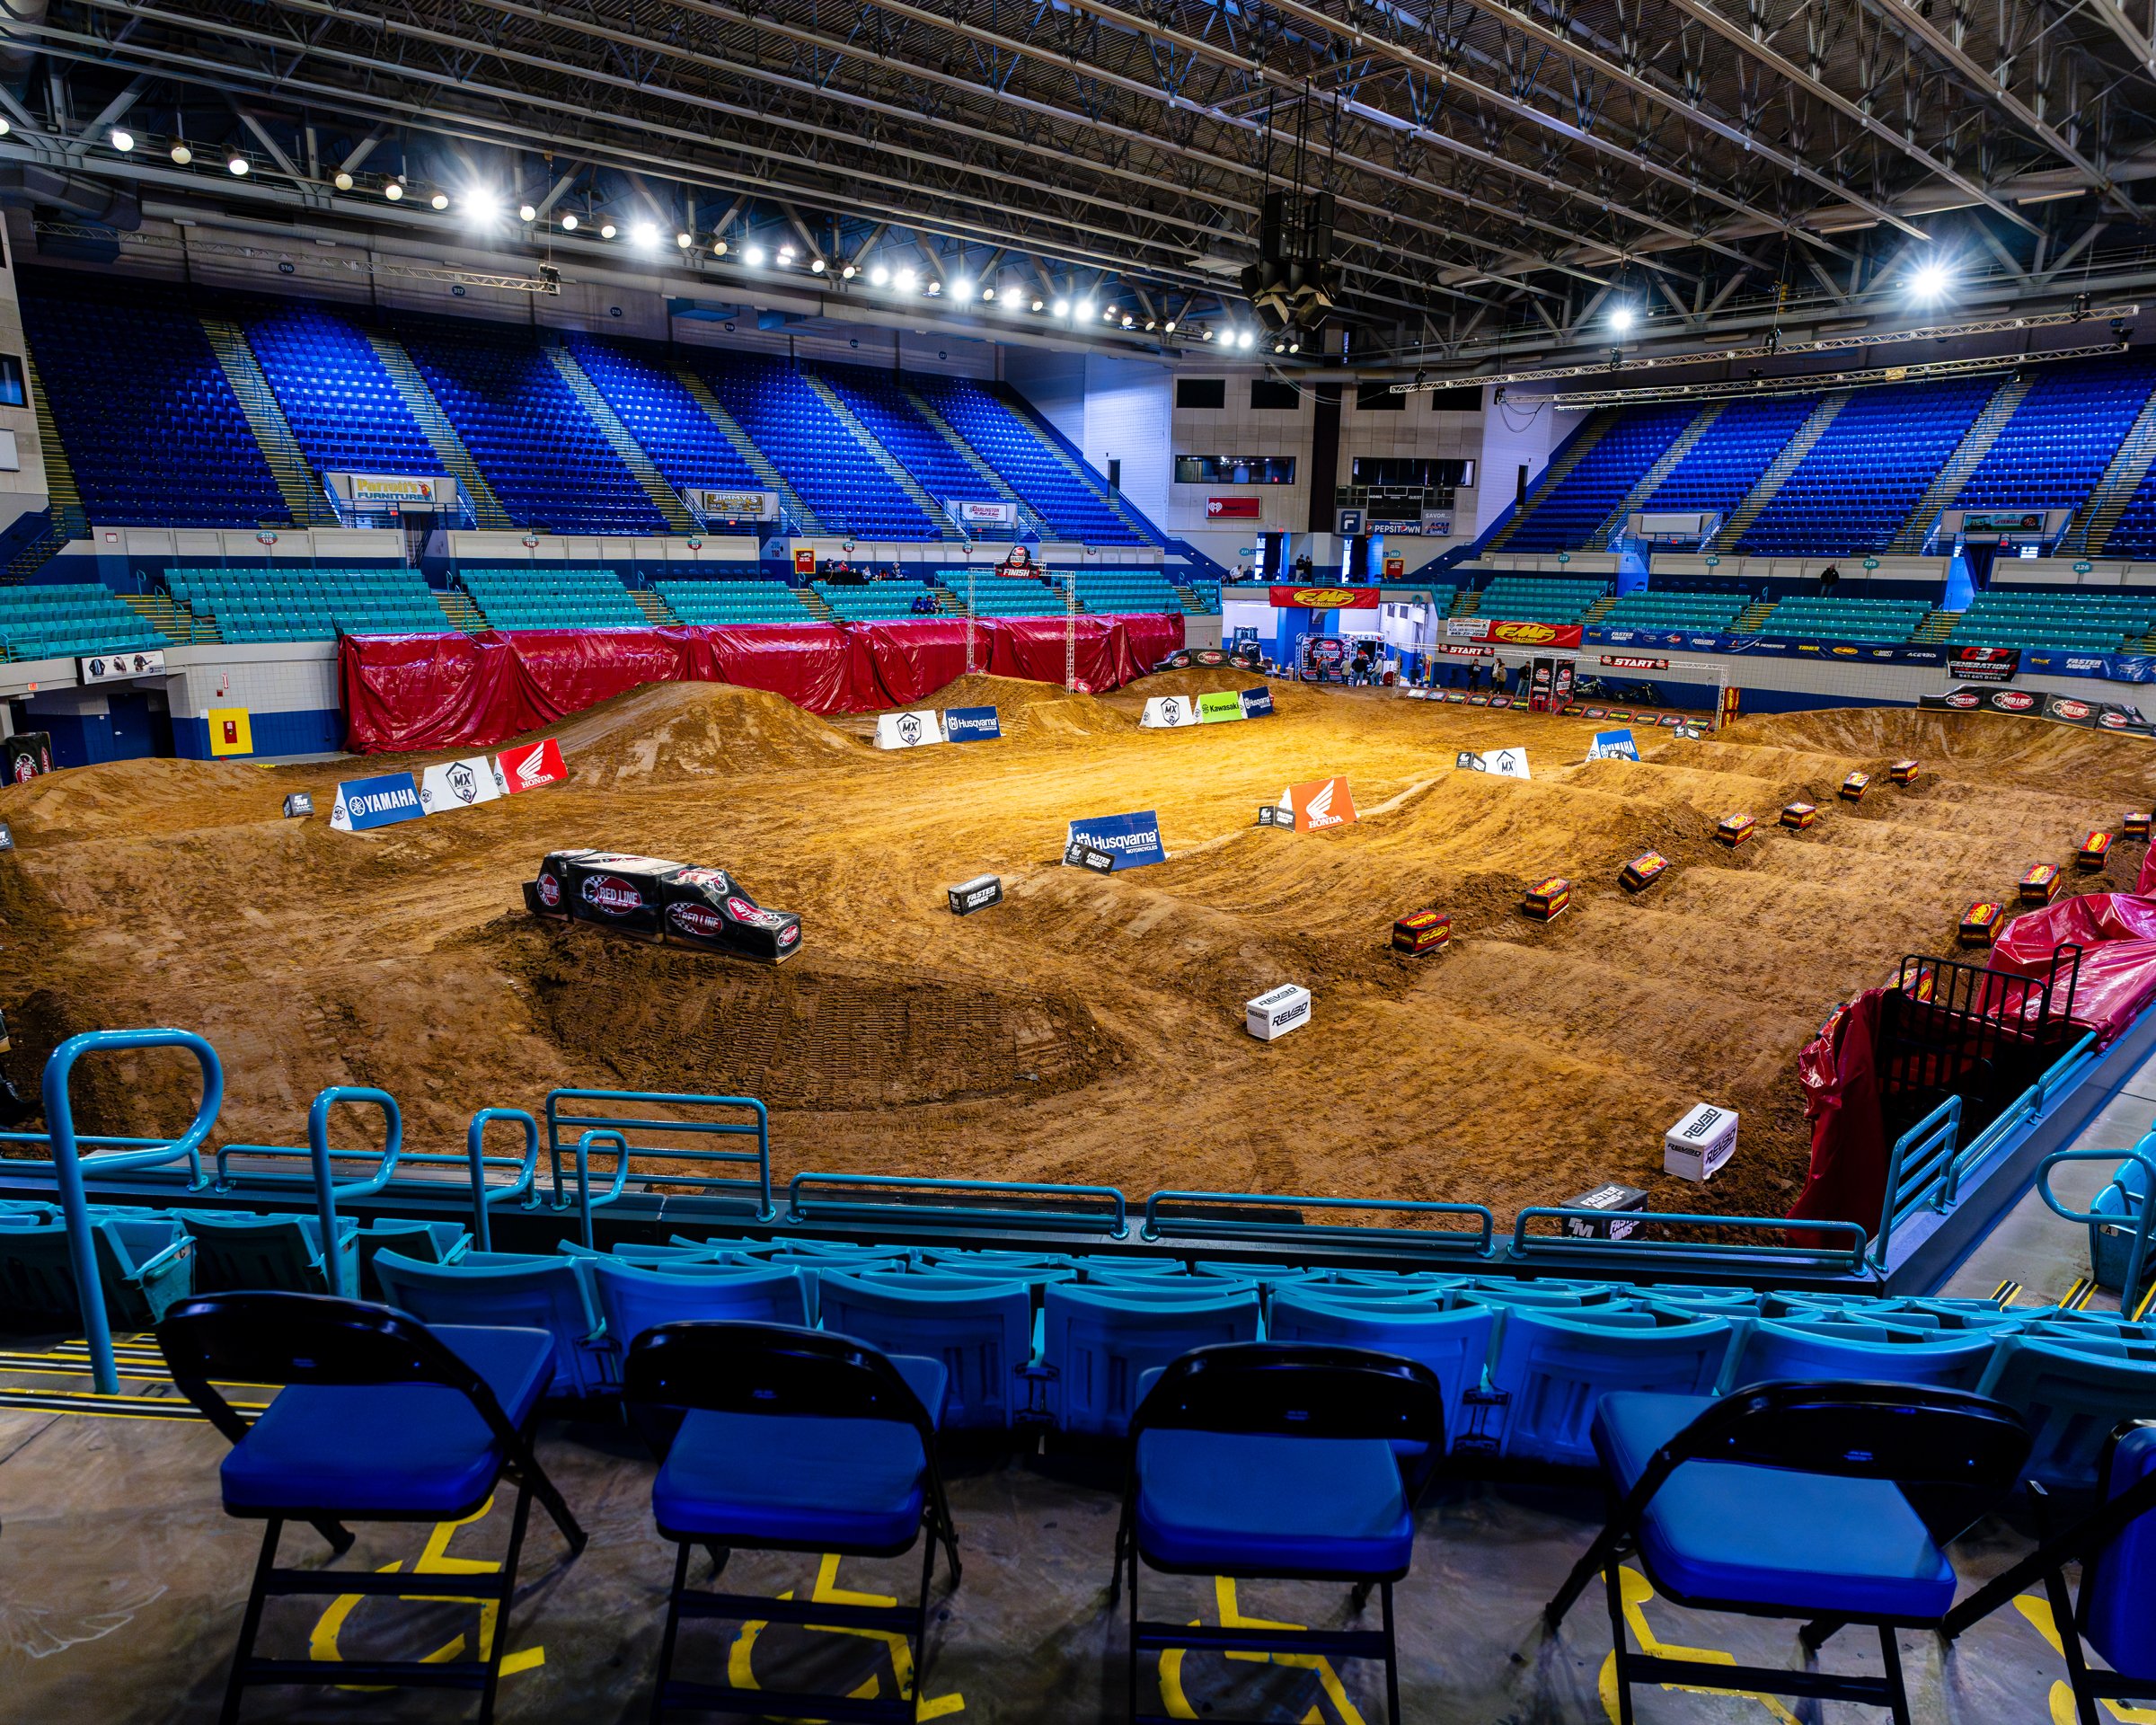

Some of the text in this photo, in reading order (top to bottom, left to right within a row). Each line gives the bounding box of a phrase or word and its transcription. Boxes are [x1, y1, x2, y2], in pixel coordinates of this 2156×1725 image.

[280, 263, 293, 271] 316
[358, 492, 429, 500] FURNITURE
[713, 495, 757, 503] JIMMY'S
[1003, 569, 1029, 577] FINISH
[1450, 647, 1482, 655] START
[1961, 647, 2008, 660] G3P
[1165, 705, 1177, 714] MX
[1210, 703, 1239, 712] Kawasaki
[902, 722, 918, 732] MX
[959, 717, 997, 730] Husqvarna
[1502, 761, 1514, 772] MX
[455, 773, 471, 788] MX
[521, 774, 554, 790] HONDA
[363, 788, 418, 813] YAMAHA
[1308, 816, 1344, 828] HONDA
[1092, 830, 1158, 850] Husqvarna
[1087, 852, 1111, 864] FASTER
[599, 887, 639, 905] RED LINE
[967, 886, 995, 903] FASTER
[968, 895, 989, 907] MINIS
[700, 916, 720, 927] LINE
[1259, 987, 1297, 1006] REV3D
[1272, 1002, 1308, 1026] REV3D
[1683, 1109, 1720, 1139] REV3D
[1667, 1143, 1701, 1157] REV3D
[1706, 1127, 1736, 1164] REV3D
[1580, 1186, 1620, 1207] FASTER
[1568, 1217, 1595, 1238] FM
